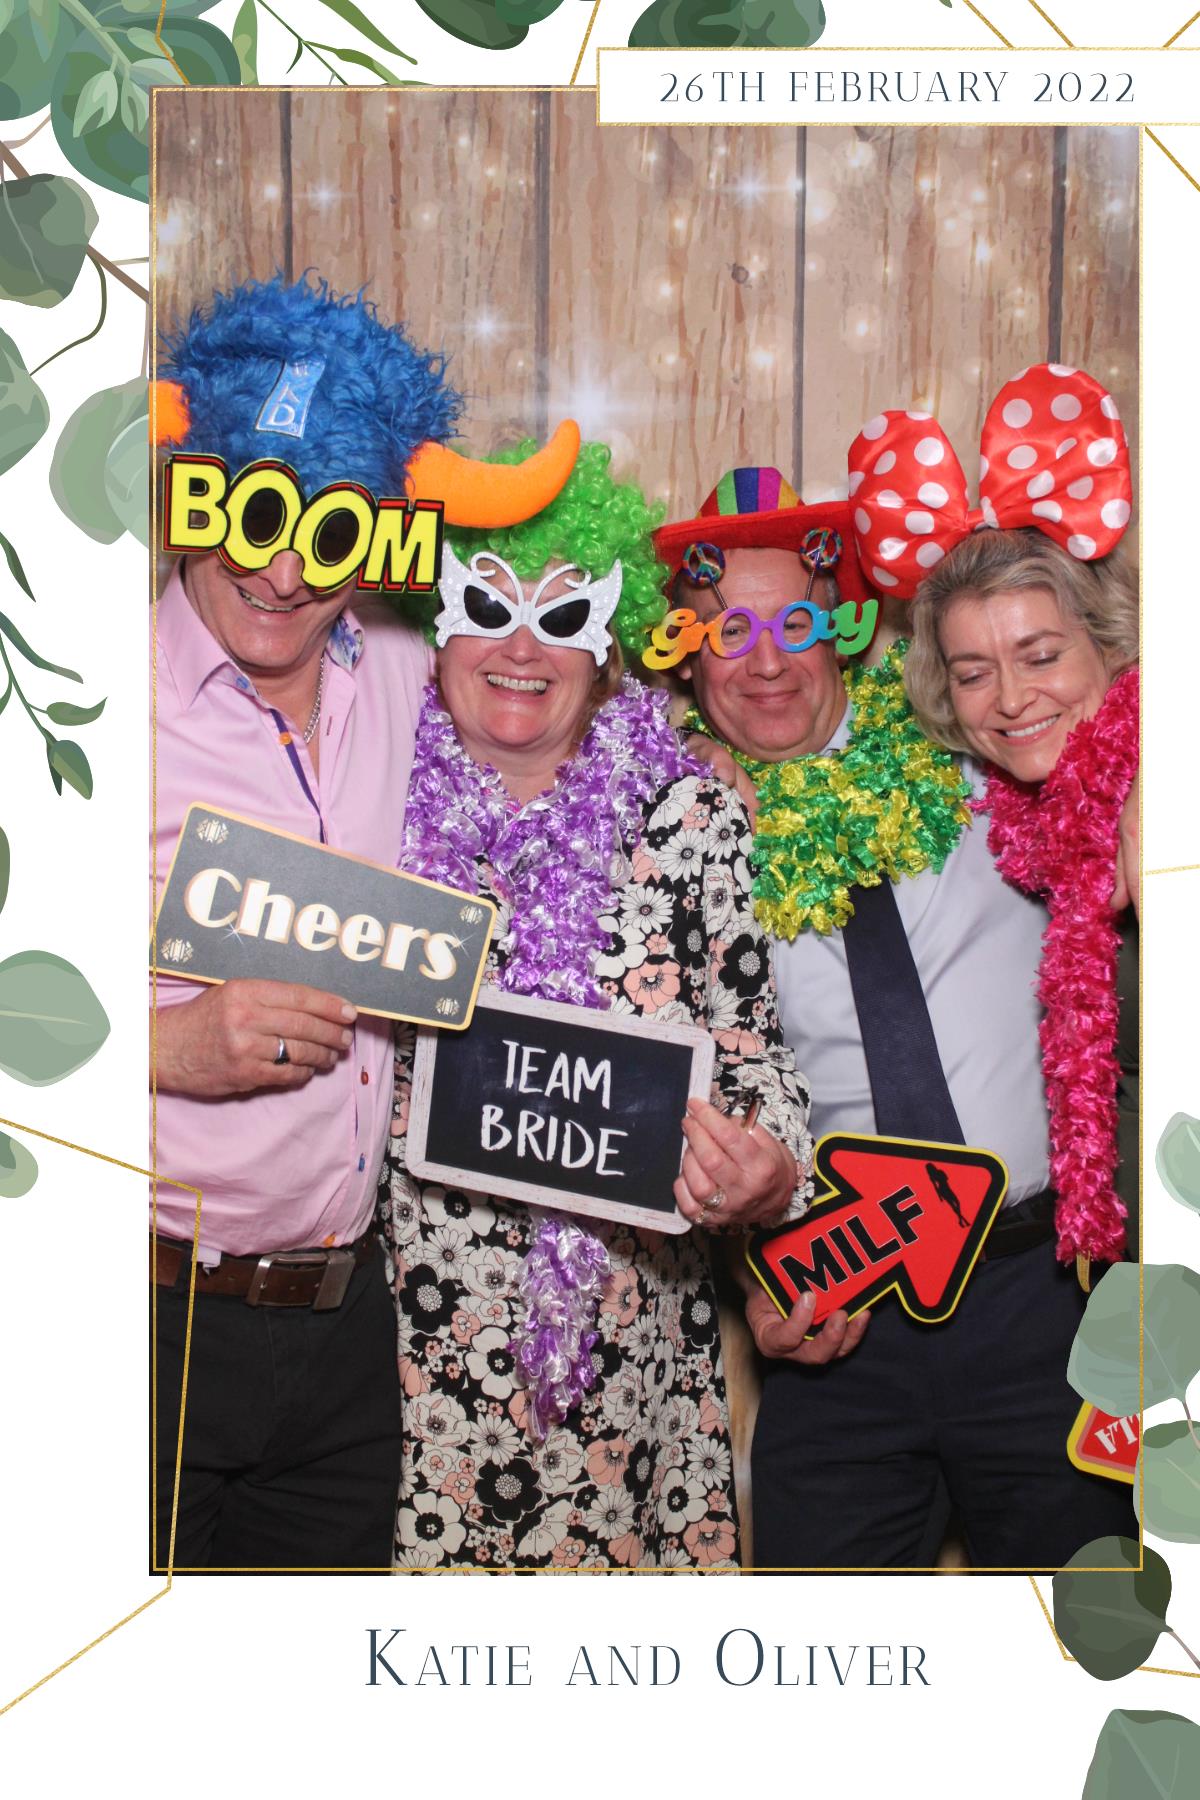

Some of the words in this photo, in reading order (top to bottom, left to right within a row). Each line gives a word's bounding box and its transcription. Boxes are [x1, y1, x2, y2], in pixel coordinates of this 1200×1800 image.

[164, 455, 443, 592] BOOM
[184, 867, 460, 981] Cheers
[502, 1039, 612, 1110] TEAM
[480, 1103, 629, 1177] BRIDE
[778, 1184, 925, 1297] MILF
